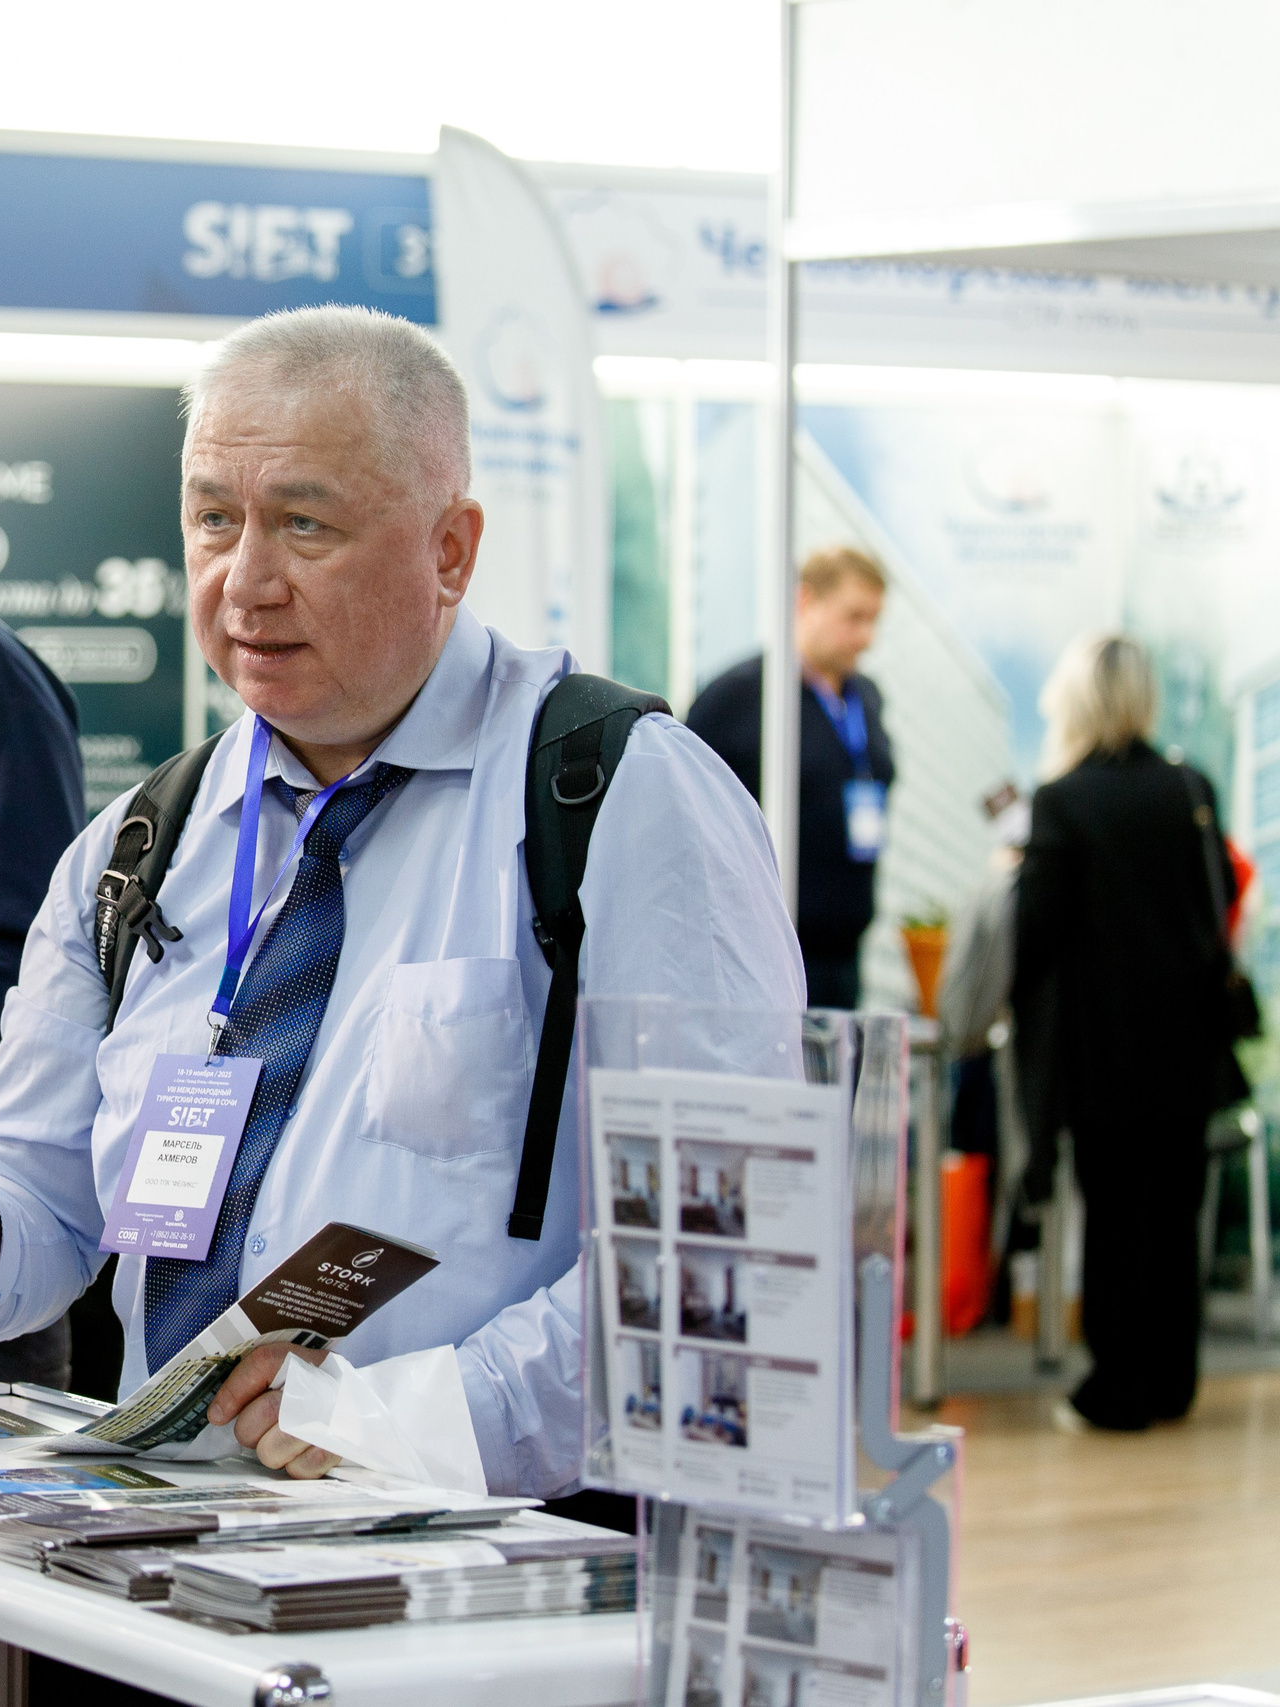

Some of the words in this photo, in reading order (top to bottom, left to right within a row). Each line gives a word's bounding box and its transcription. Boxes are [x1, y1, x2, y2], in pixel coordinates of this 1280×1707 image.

[177, 1068, 192, 1076] 18-19
[192, 1069, 214, 1078] ноября
[218, 1070, 232, 1079] 2025
[176, 1086, 232, 1097] МЕЖДУНАРОДНЫЙ
[156, 1095, 193, 1104] ТУРИСТСКИЙ
[193, 1096, 216, 1105] ФОРУМ
[220, 1098, 238, 1106] СОЧИ
[162, 1139, 203, 1150] МАРСЕЛЬ
[157, 1153, 198, 1164] АХМЕРОВ
[118, 1230, 139, 1242] СОУД
[151, 1240, 188, 1249] tour-forum.com
[317, 1262, 376, 1287] STORK
[317, 1276, 350, 1291] HOTEL
